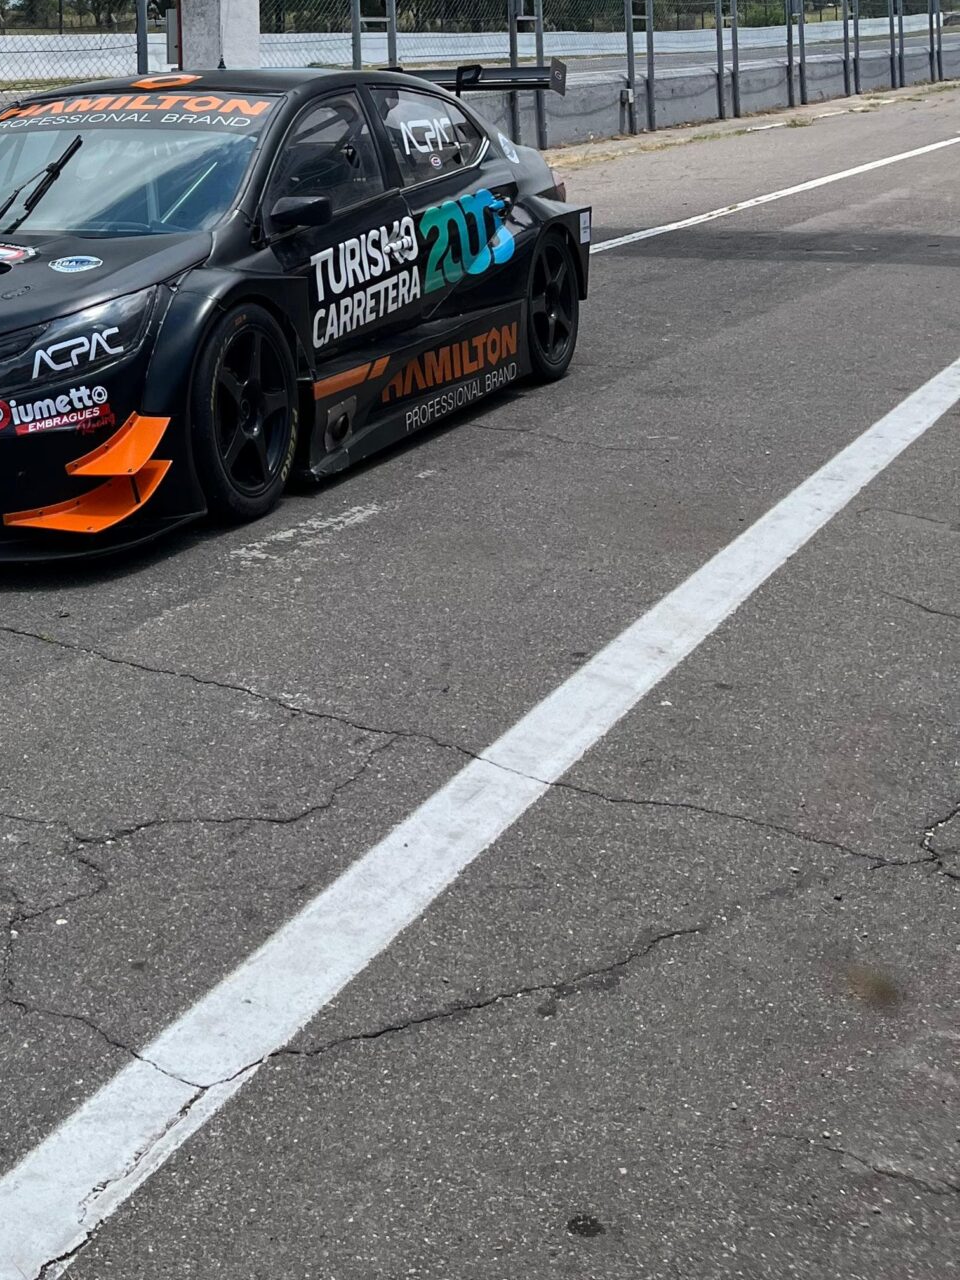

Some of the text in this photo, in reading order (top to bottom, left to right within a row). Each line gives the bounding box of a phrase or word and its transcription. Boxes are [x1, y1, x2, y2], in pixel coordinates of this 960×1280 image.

[160, 113, 250, 128] BRAND
[312, 266, 421, 349] CARRETERA
[32, 327, 124, 380] ACPAC
[382, 322, 518, 403] HAMILTON
[28, 407, 100, 432] EMBRAGUES
[406, 362, 517, 432] PROFESSIONAL BRAND
